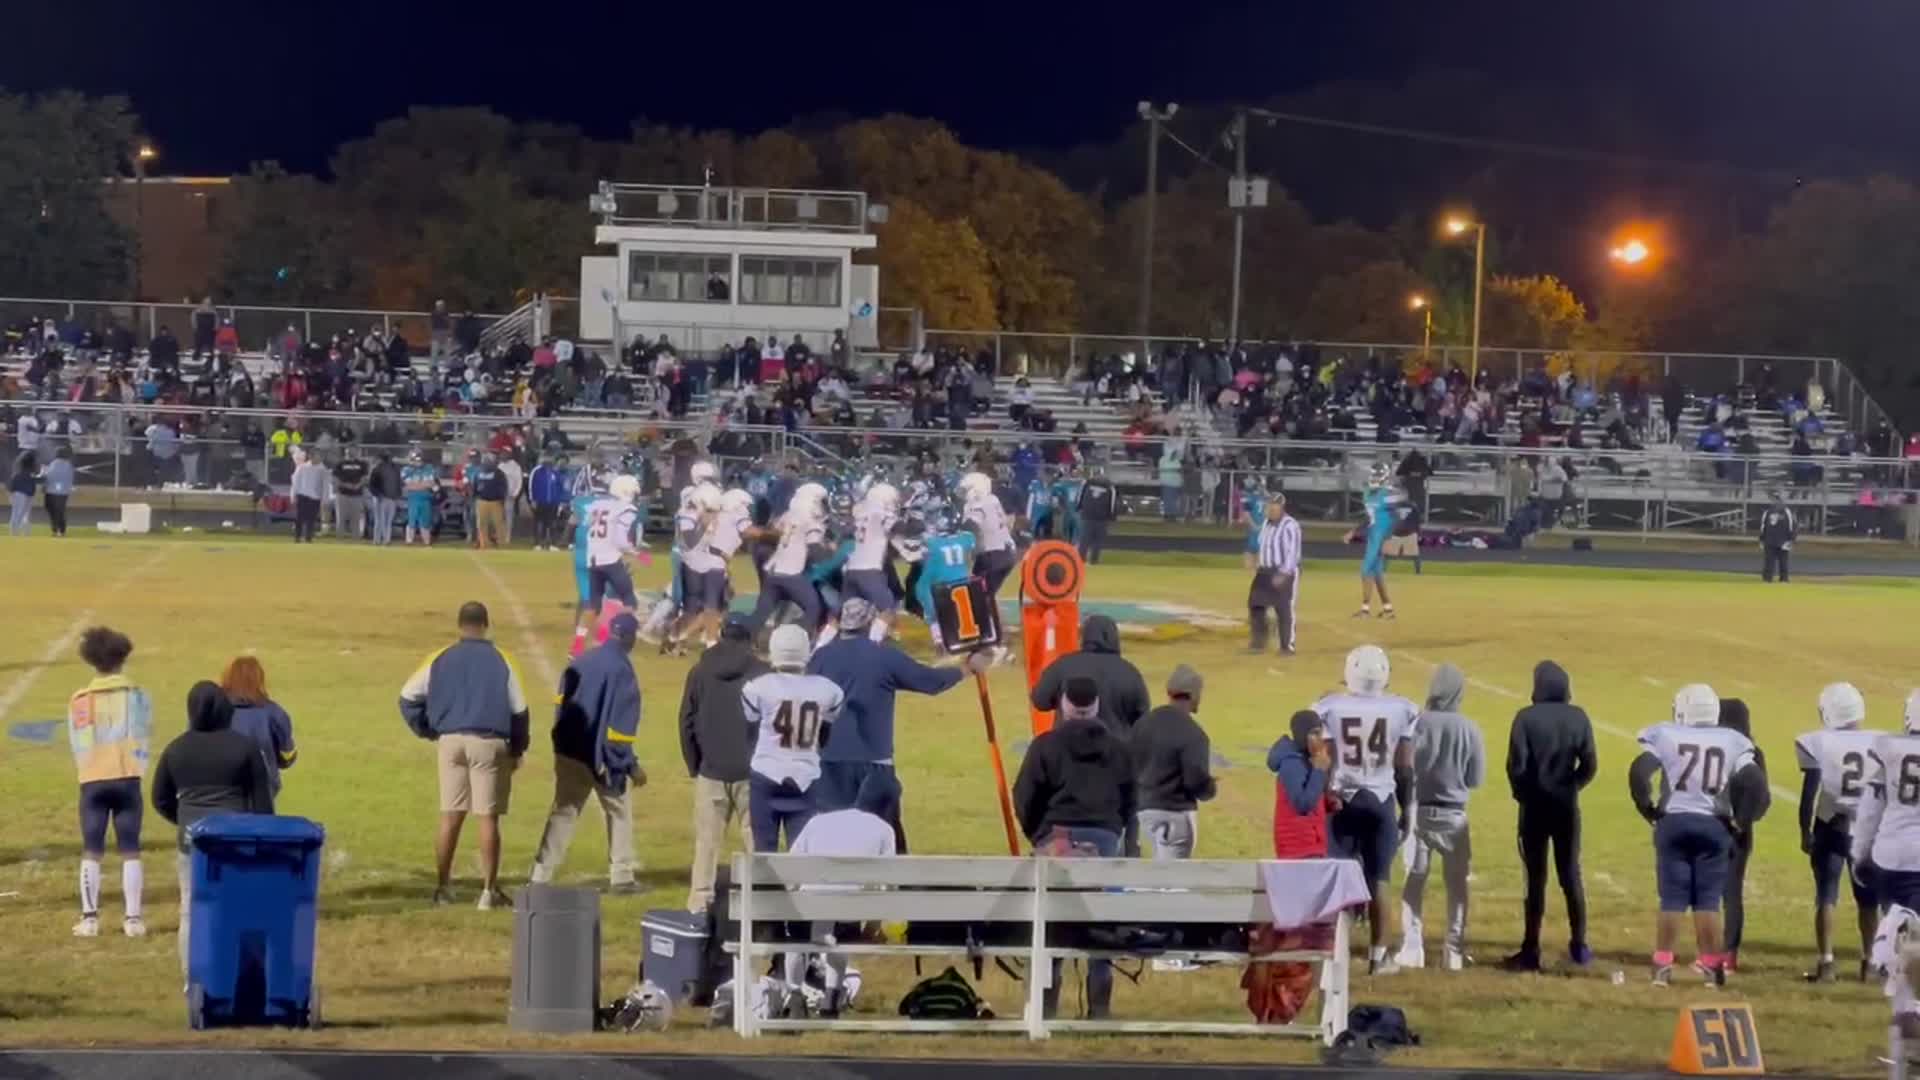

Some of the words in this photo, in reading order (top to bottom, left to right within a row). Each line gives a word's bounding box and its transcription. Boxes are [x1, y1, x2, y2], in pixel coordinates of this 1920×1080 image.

[950, 585, 980, 640] 1
[773, 700, 819, 748] 40
[1341, 717, 1388, 768] 54
[1675, 743, 1725, 795] 70
[1694, 1007, 1759, 1068] 50
